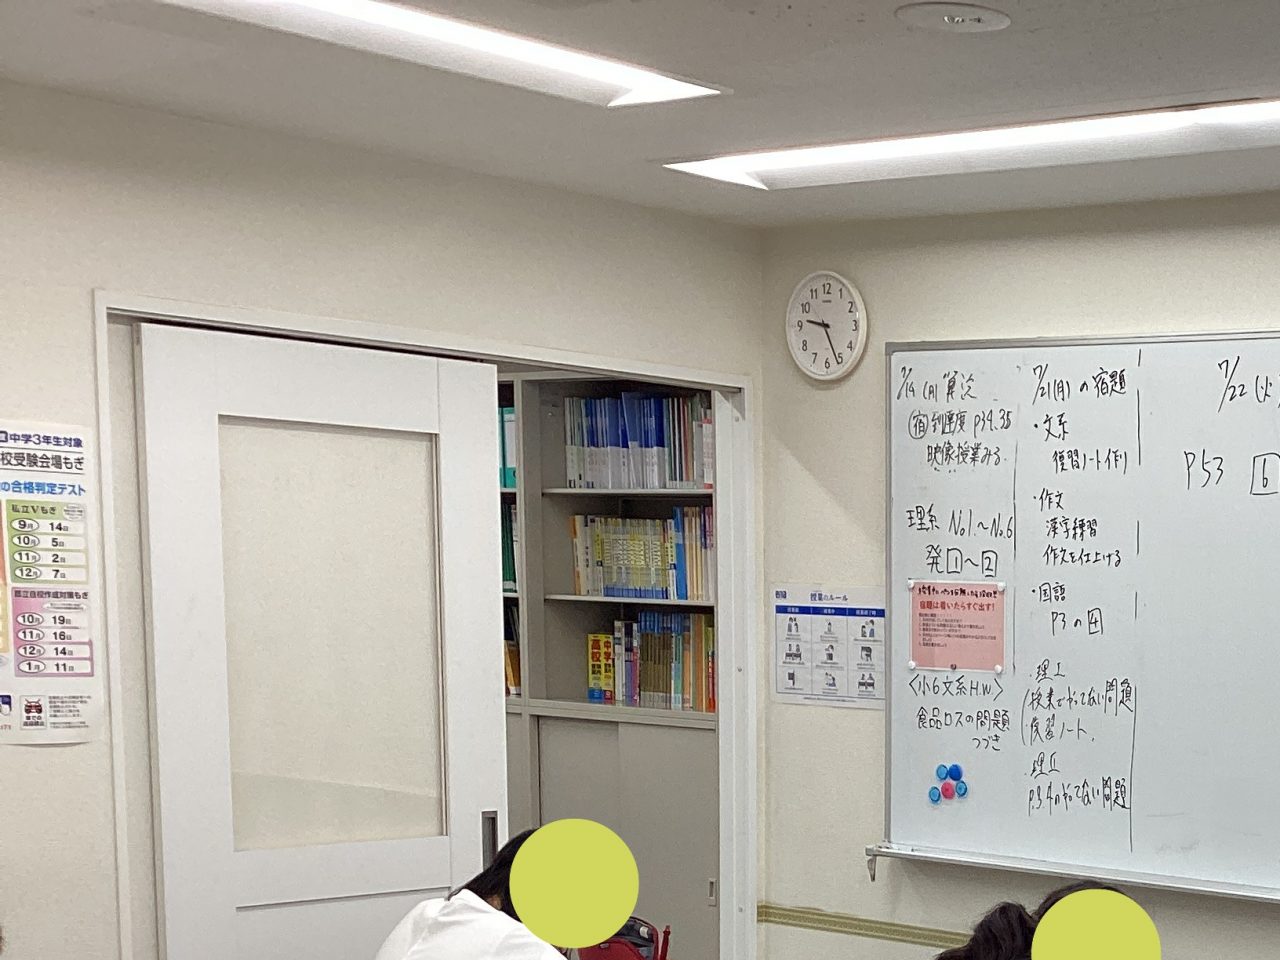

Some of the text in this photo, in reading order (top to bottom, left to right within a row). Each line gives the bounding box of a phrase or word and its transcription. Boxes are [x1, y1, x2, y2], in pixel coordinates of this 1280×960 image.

[810, 288, 818, 299] 11
[822, 282, 832, 295] 12
[838, 288, 843, 299] 1
[801, 302, 810, 314] 10
[848, 301, 854, 313] 2
[797, 320, 803, 332] 9
[852, 320, 858, 331] 3
[802, 339, 808, 351] 8
[846, 340, 853, 351] 4
[812, 353, 818, 364] 7
[824, 357, 830, 369] 6
[1184, 449, 1224, 490] P53
[0, 480, 86, 496] の合格判定テスト
[906, 503, 940, 532] 理系
[916, 706, 1010, 732] 食品ロスの問題
[972, 734, 1001, 751] つづき
